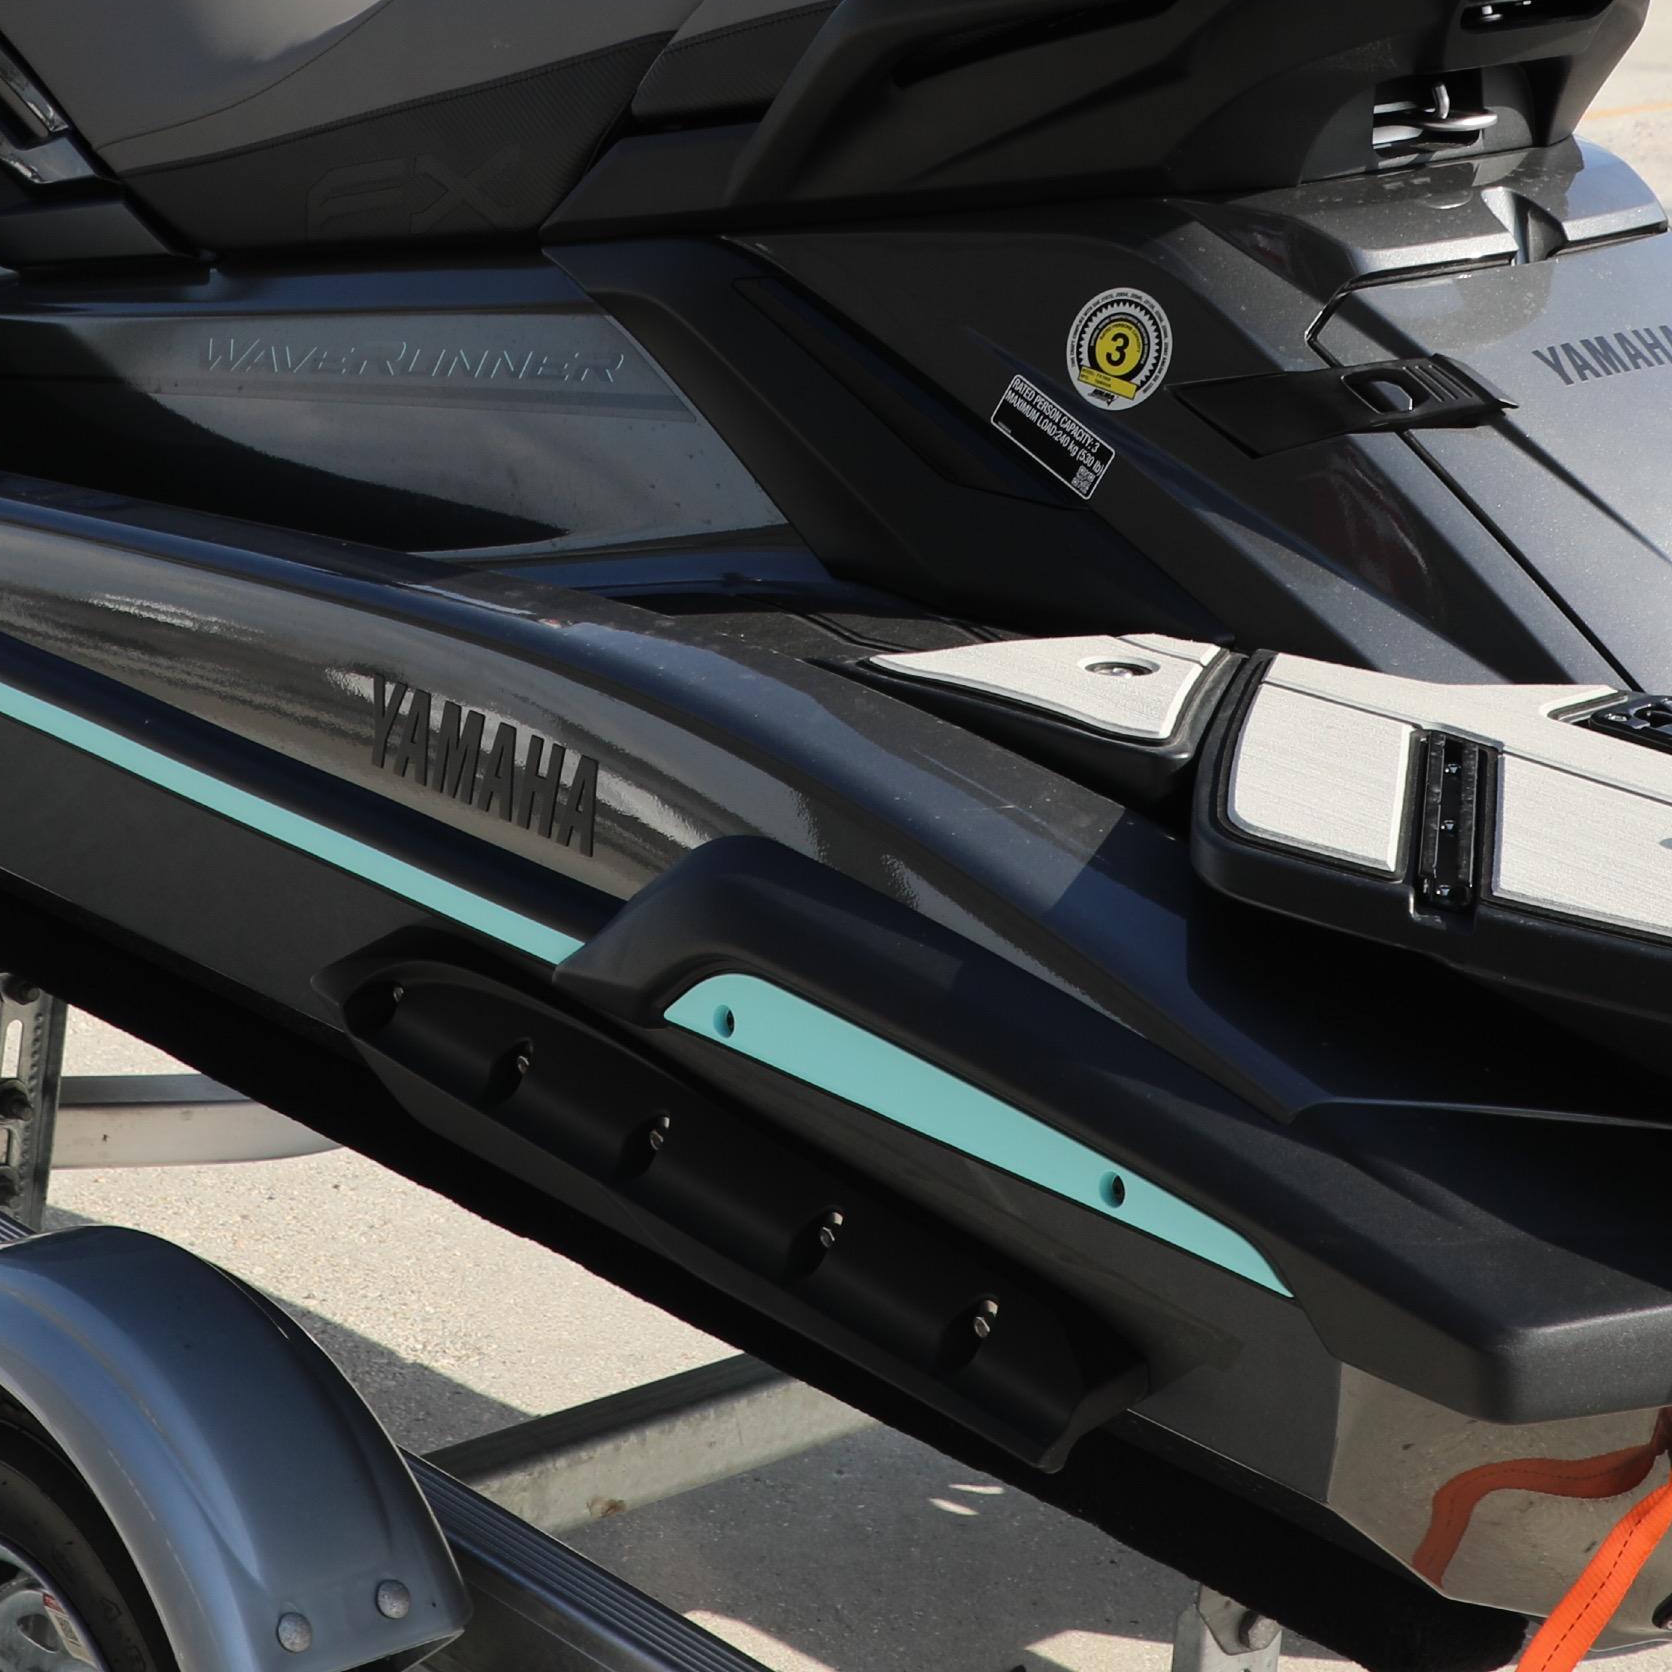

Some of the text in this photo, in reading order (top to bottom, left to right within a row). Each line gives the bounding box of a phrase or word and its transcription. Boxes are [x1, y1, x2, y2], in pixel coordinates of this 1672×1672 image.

[1105, 332, 1130, 366] 3
[1004, 389, 1040, 423] MAXIMUM
[1067, 440, 1079, 457] kg
[1012, 378, 1100, 453] RATED PERSON CAPACITY: 3
[371, 675, 599, 859] YAMAHA
